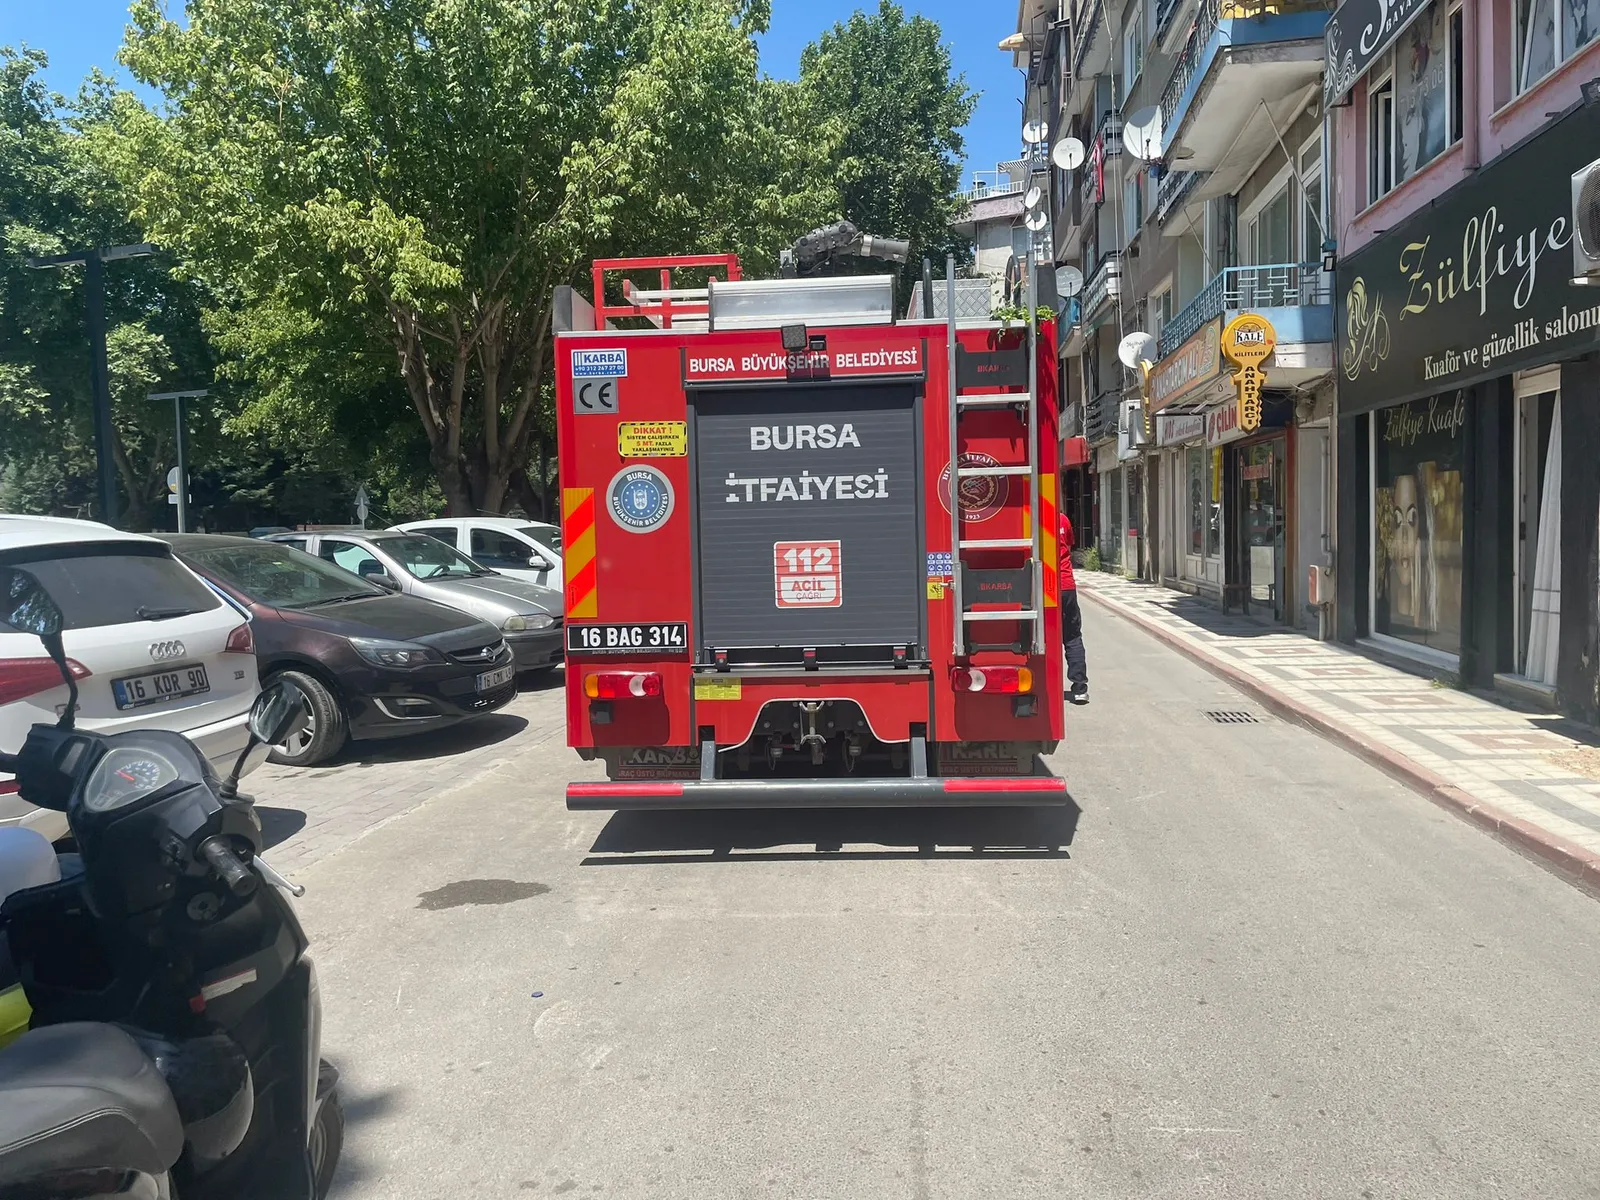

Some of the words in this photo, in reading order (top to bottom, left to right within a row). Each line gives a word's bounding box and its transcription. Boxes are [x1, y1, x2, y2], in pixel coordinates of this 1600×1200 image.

[1400, 206, 1574, 320] Zülfiye
[1236, 331, 1264, 342] KALE
[1424, 350, 1460, 380] Kuaför
[1463, 349, 1478, 366] ve
[1482, 318, 1540, 369] güzellik
[584, 353, 623, 363] KARBA
[689, 357, 735, 373] BURSA
[741, 351, 830, 373] BÜYÜKŞEHİR
[836, 346, 918, 368] BELEDİYESİ
[579, 382, 613, 409] CE
[633, 426, 667, 434] DİKKAT
[750, 423, 861, 451] BURSA
[1383, 403, 1424, 447] Zülfiye
[626, 472, 652, 481] BURSA
[725, 467, 889, 503] İTFAİYESİ
[783, 546, 833, 572] 112
[791, 577, 826, 592] ACİL
[795, 591, 822, 601] ÇAĞRI
[581, 627, 601, 648] 16
[606, 626, 643, 647] BAG
[649, 625, 682, 646] 314
[126, 681, 146, 700] 16
[154, 673, 181, 695] KOR
[187, 669, 205, 688] 90
